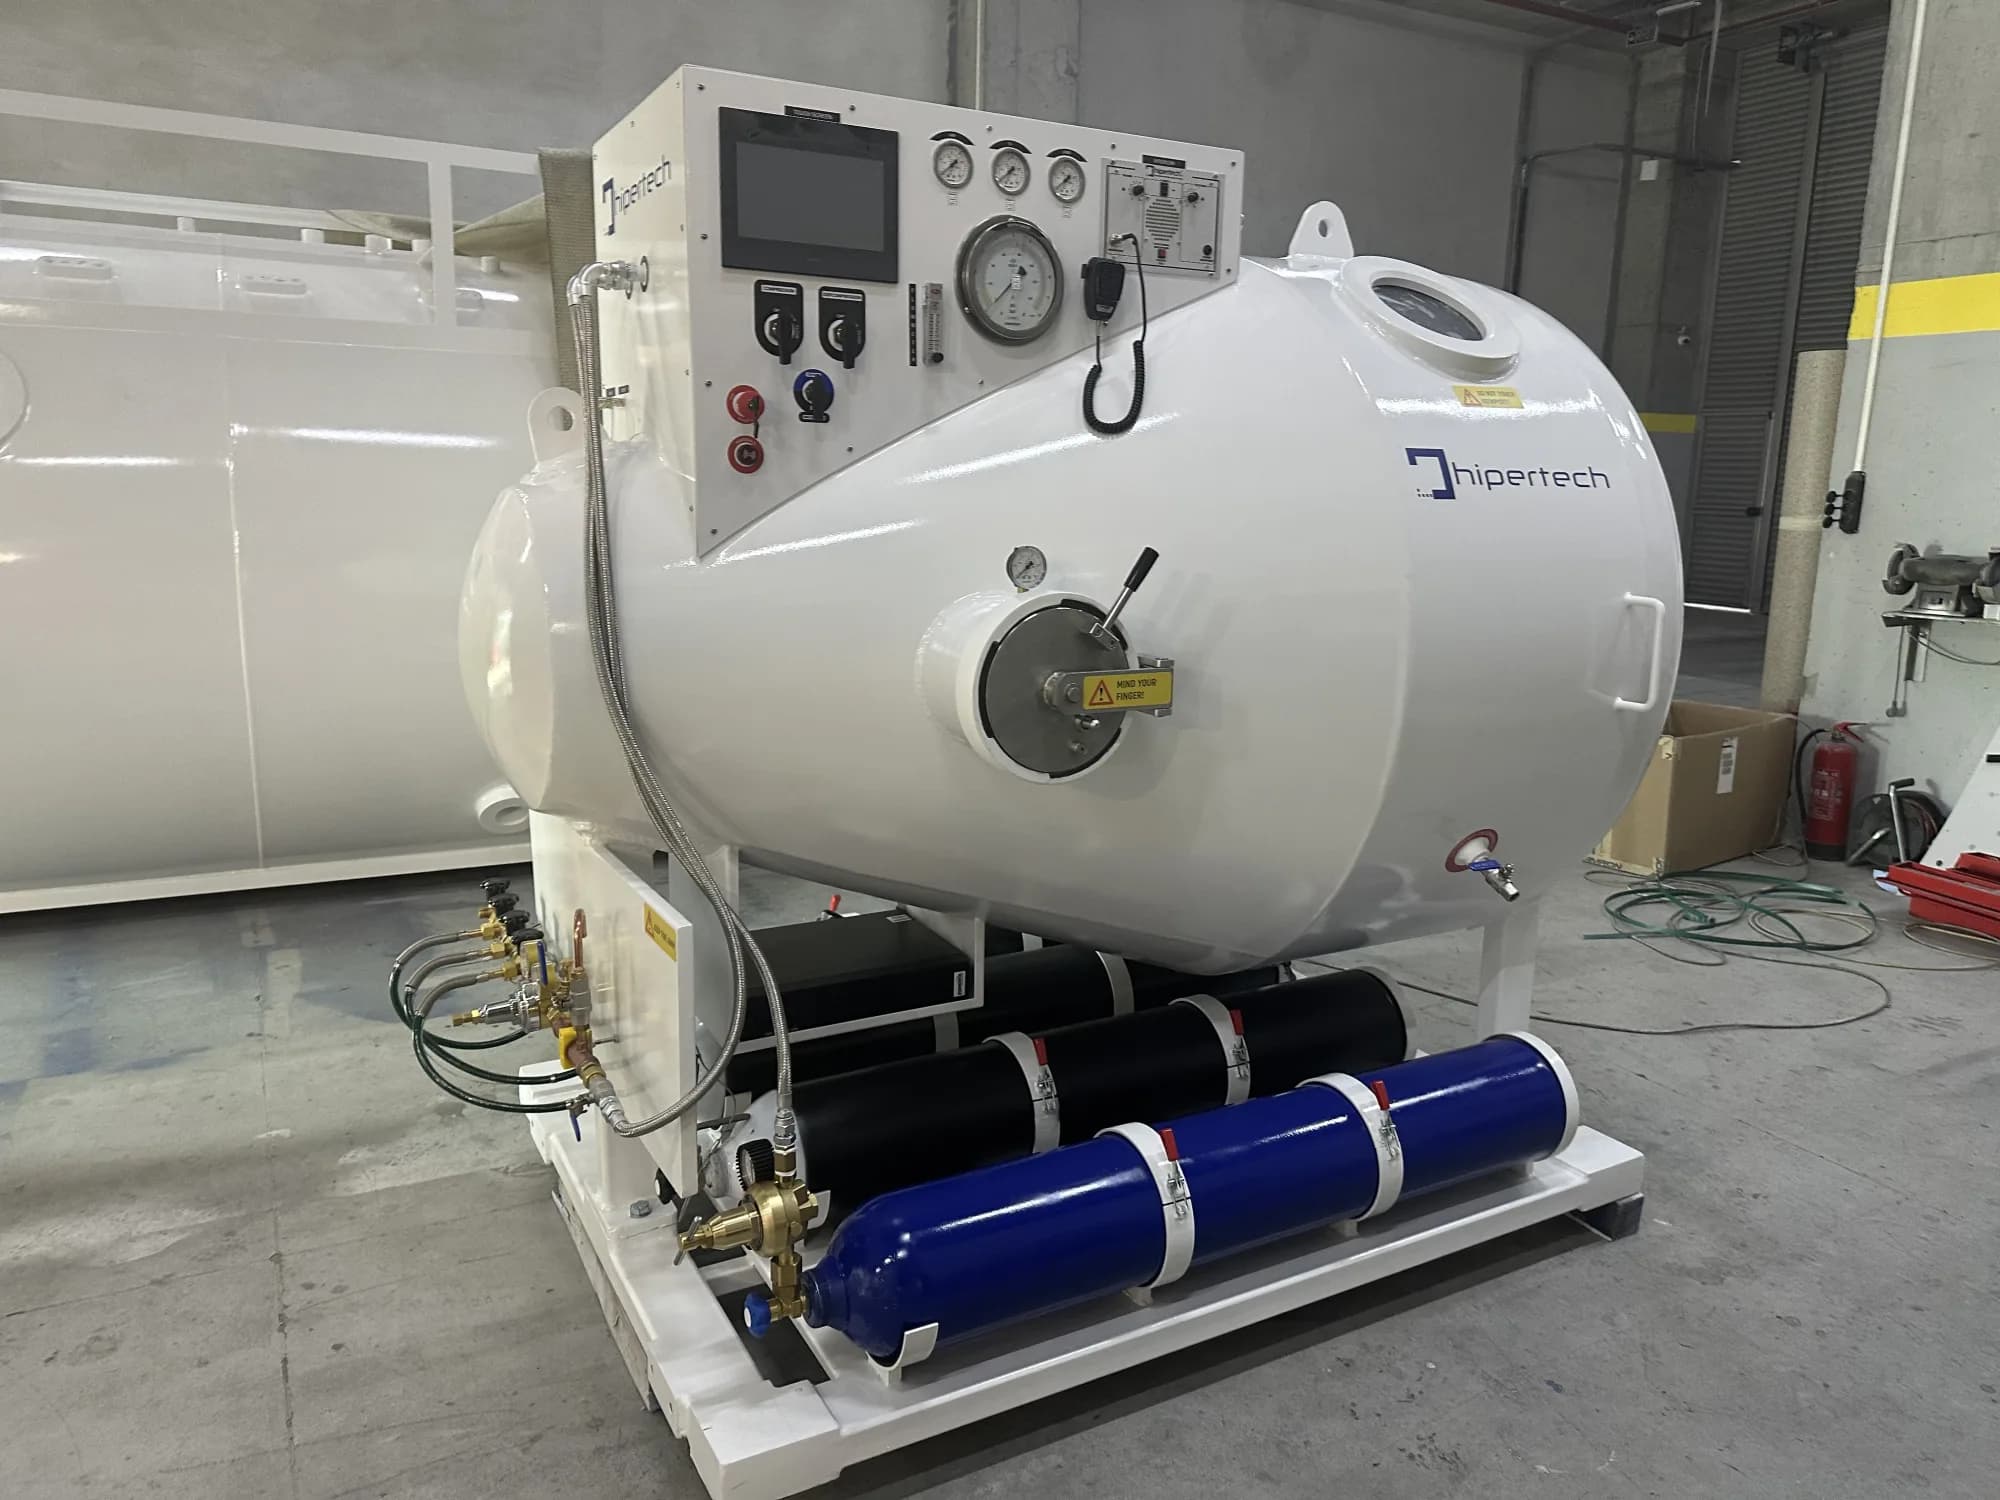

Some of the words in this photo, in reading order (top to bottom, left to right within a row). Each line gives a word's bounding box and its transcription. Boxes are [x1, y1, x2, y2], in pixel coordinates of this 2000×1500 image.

[614, 154, 672, 216] hipertech
[1451, 461, 1611, 491] hipertech
[1116, 679, 1136, 689] MIND
[1138, 678, 1158, 688] YOUR
[1116, 691, 1145, 701] FINGER!
